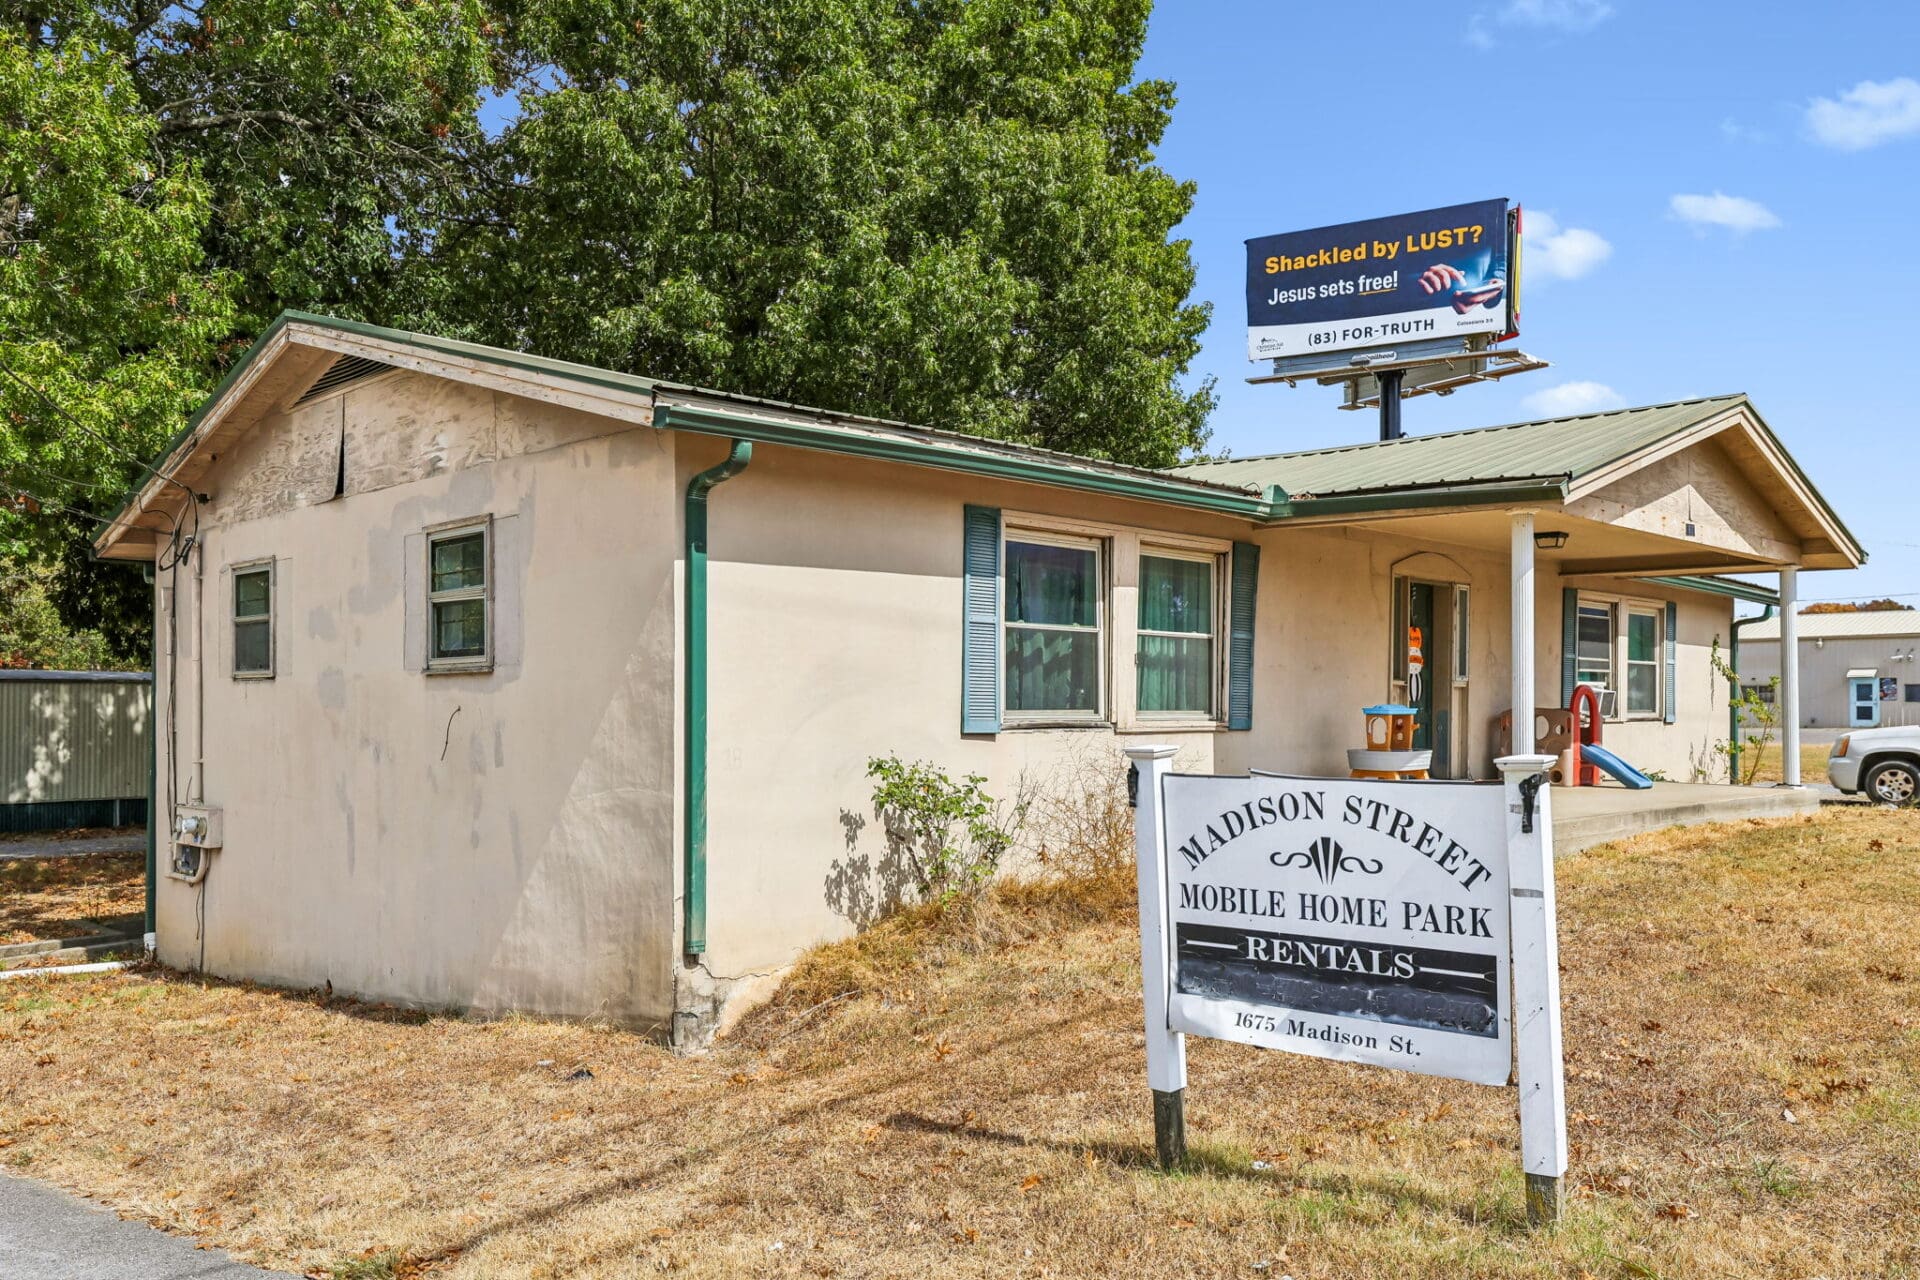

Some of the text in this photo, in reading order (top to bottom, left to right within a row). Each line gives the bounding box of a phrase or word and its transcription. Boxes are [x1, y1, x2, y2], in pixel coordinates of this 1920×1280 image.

[1264, 225, 1483, 274] Shackled by LUST?
[1268, 271, 1398, 305] Jesus sets free!
[1308, 318, 1435, 346] (83) FOR-TRUTH
[1178, 791, 1492, 892] MADISON STREET
[1179, 883, 1494, 938] MOBILE HOME PARK
[1245, 936, 1416, 979] RENTALS
[1234, 1012, 1421, 1056] 1675 Madison St.
